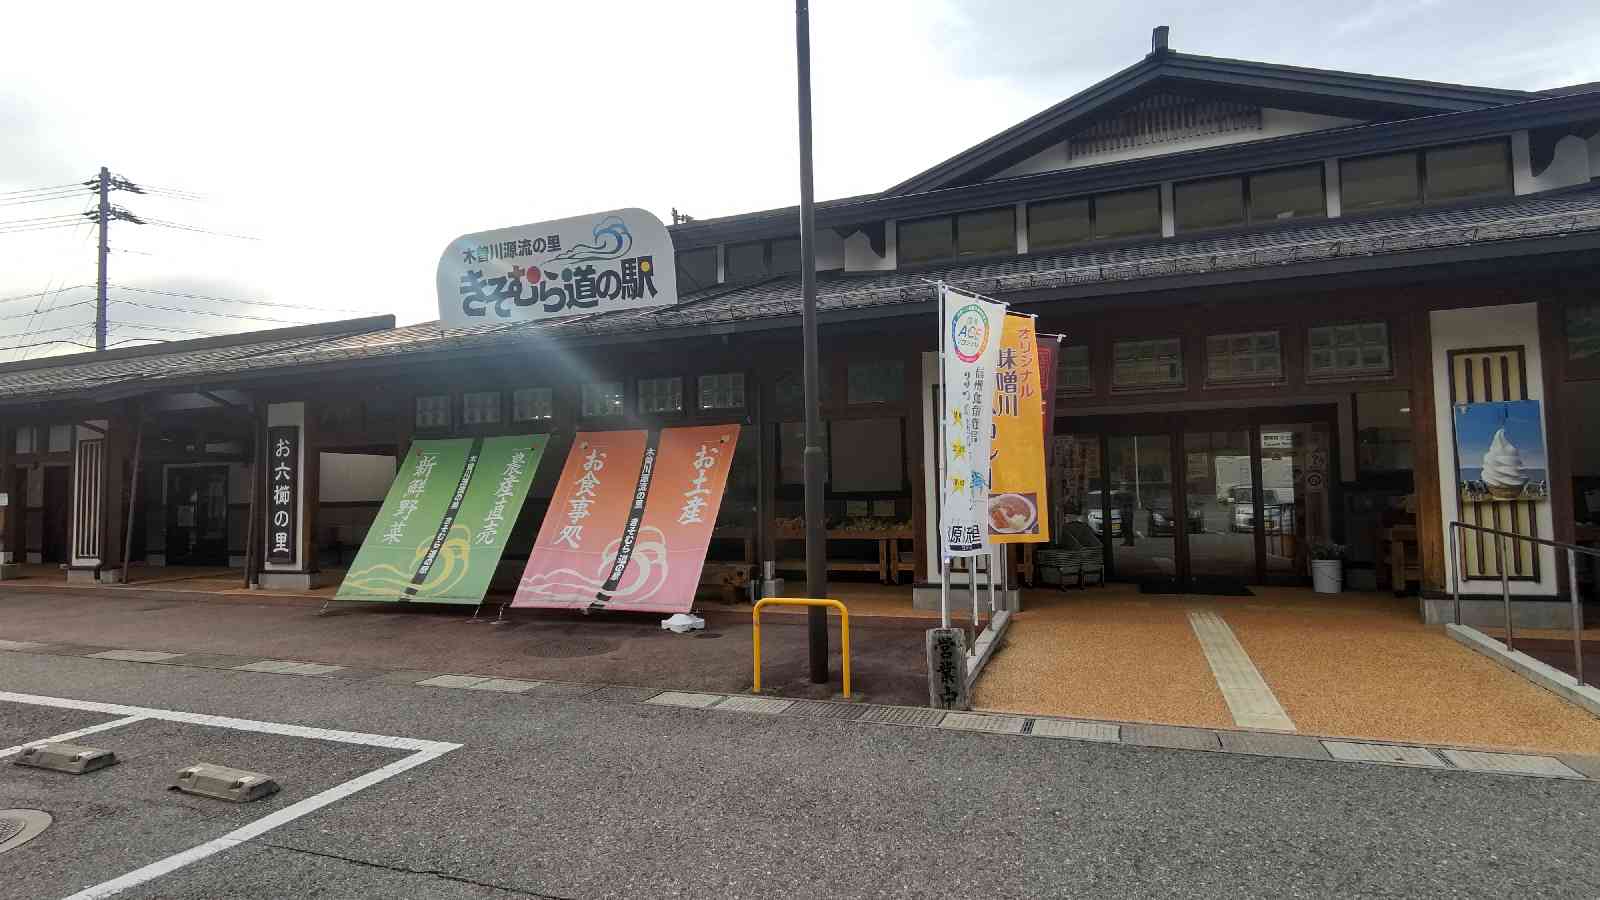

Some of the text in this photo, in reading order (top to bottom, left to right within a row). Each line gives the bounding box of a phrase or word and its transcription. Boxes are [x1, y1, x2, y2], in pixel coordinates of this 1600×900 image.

[459, 255, 658, 318] きそむら道の駅
[462, 234, 562, 265] 木曽川源流の里
[1016, 328, 1035, 400] オリジナル
[273, 438, 292, 553] お六櫛の里
[383, 455, 439, 545] 新鮮野菜
[553, 448, 608, 549] お食事処
[677, 444, 719, 525] お土産
